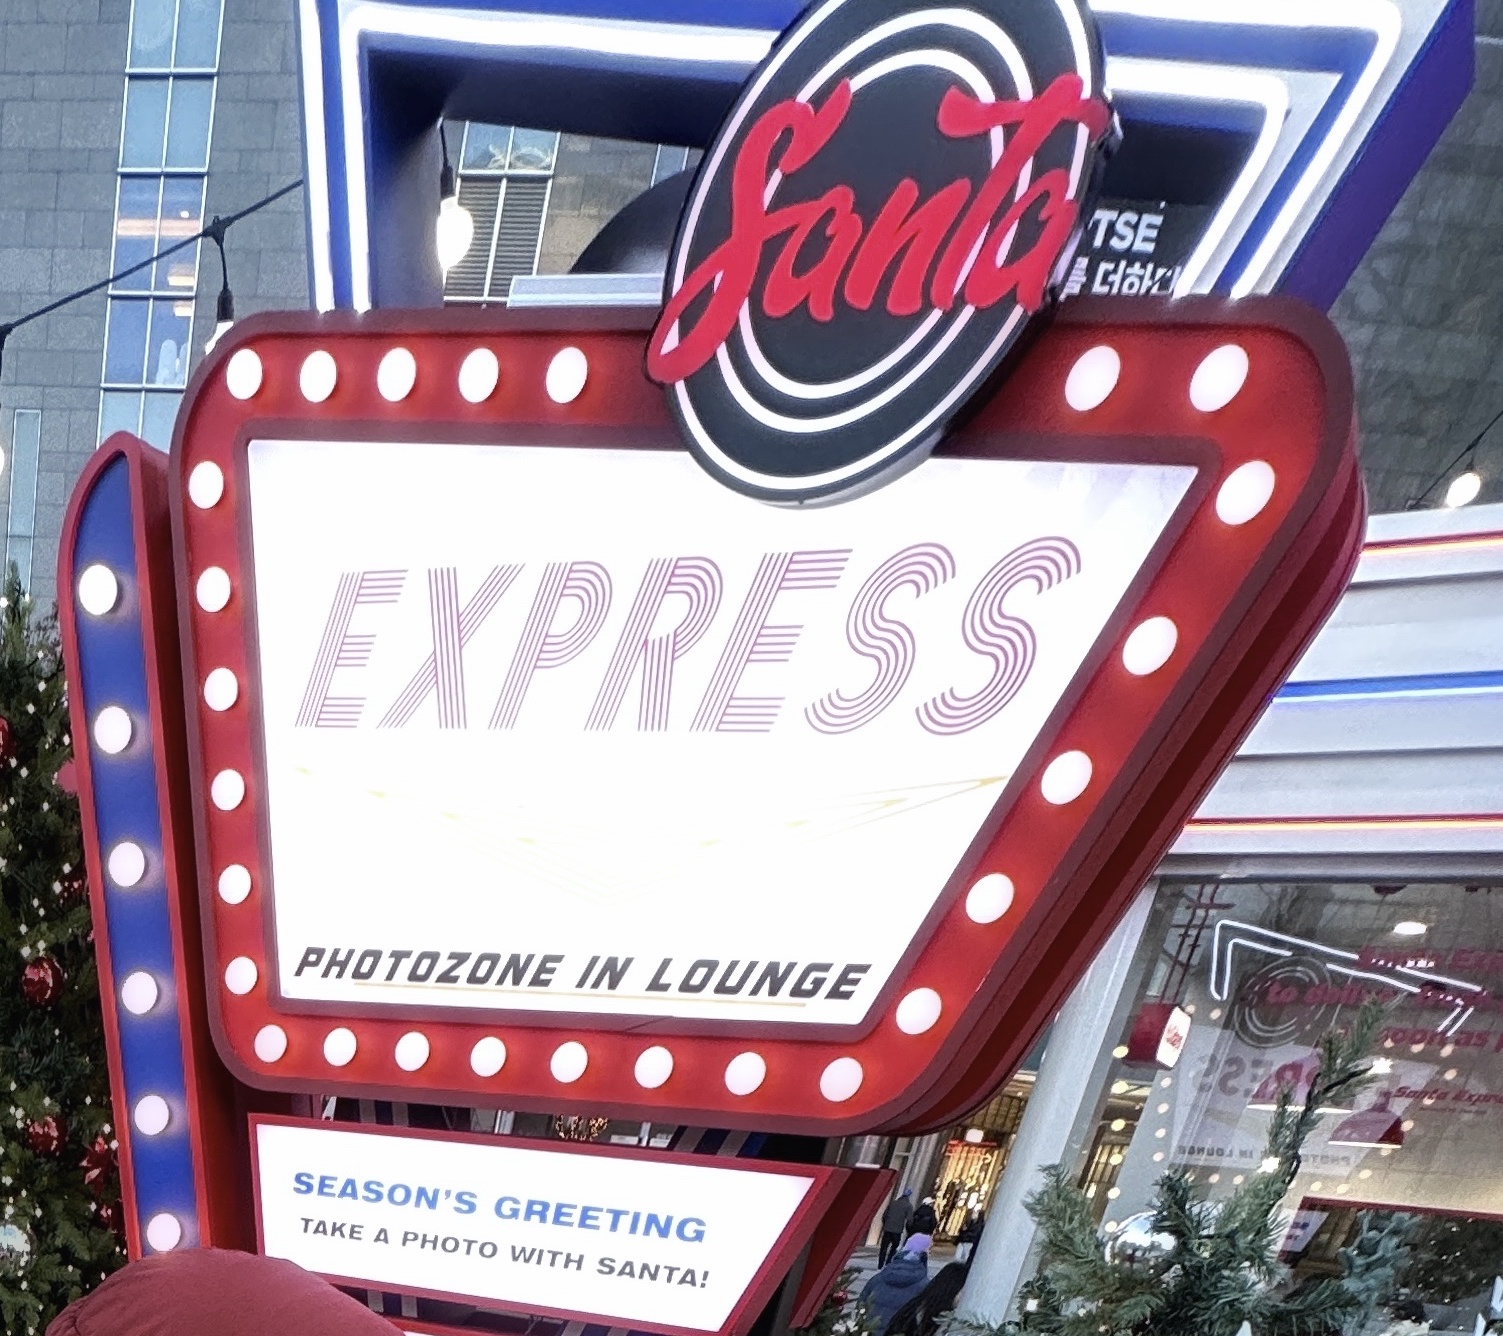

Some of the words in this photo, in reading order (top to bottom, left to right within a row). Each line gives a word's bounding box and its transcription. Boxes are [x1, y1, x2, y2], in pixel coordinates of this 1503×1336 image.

[646, 71, 1113, 384] Santa
[294, 535, 1081, 737] EXPRESS
[294, 946, 565, 988] PHOTOZONE
[574, 955, 635, 990] IN
[644, 958, 873, 1001] LOUNGE
[293, 1171, 478, 1216] SEASON'S
[493, 1195, 708, 1244] GREETING
[300, 1217, 365, 1242] TAKE
[374, 1228, 390, 1245] A
[401, 1230, 498, 1260] PHOTO
[510, 1244, 585, 1272] WITH
[596, 1256, 710, 1289] SANTA!
